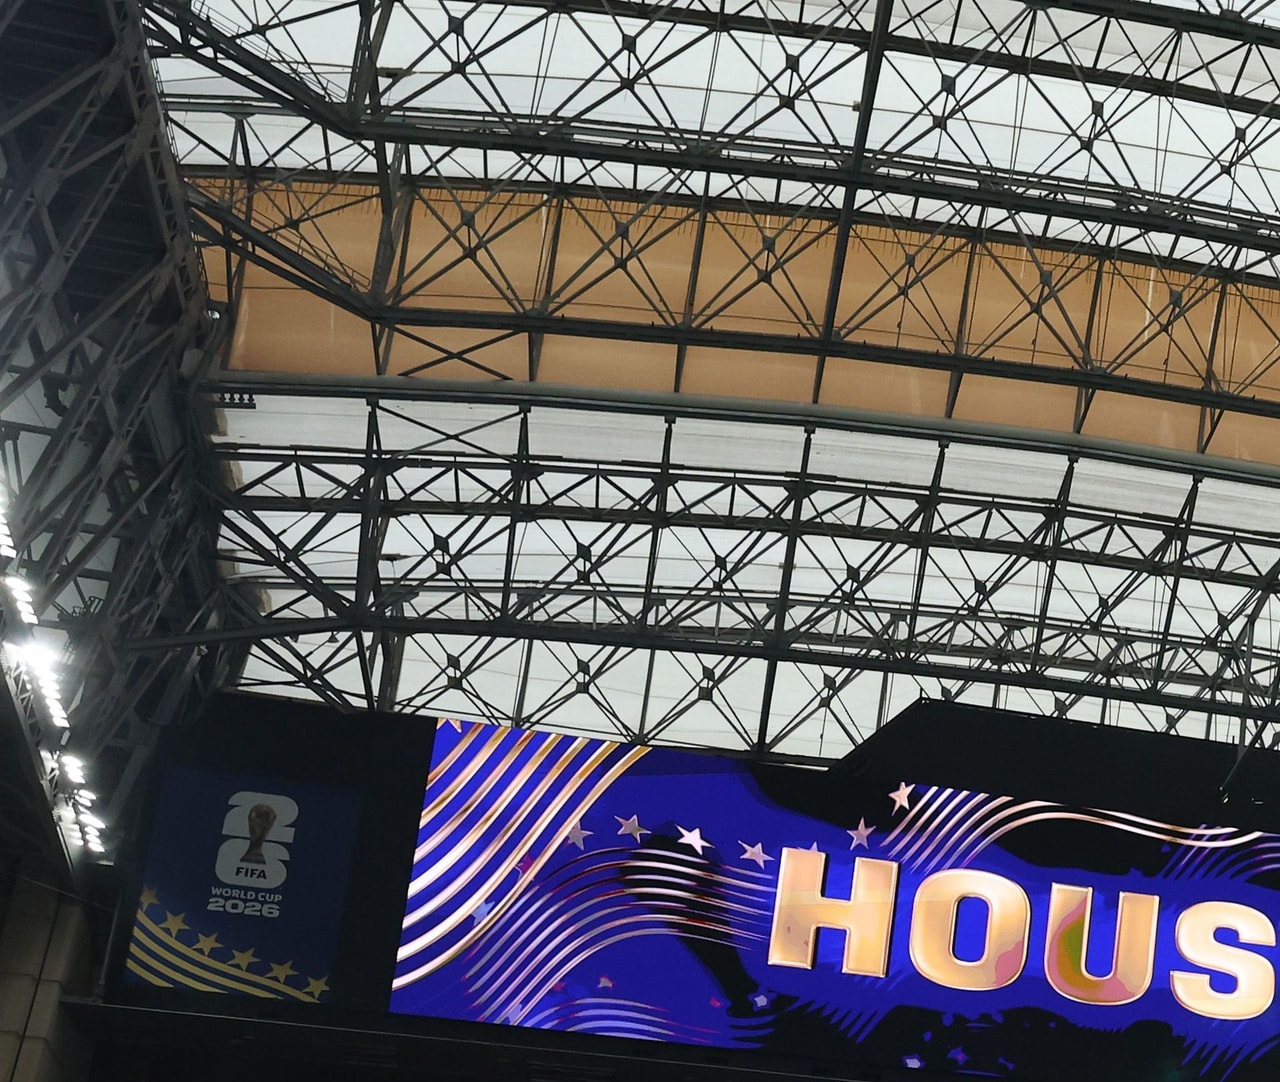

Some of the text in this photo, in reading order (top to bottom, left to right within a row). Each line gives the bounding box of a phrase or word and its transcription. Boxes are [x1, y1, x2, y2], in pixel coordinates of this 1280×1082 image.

[235, 866, 267, 880] FIFA
[211, 886, 282, 902] WORLD CUP
[207, 898, 280, 918] 2026
